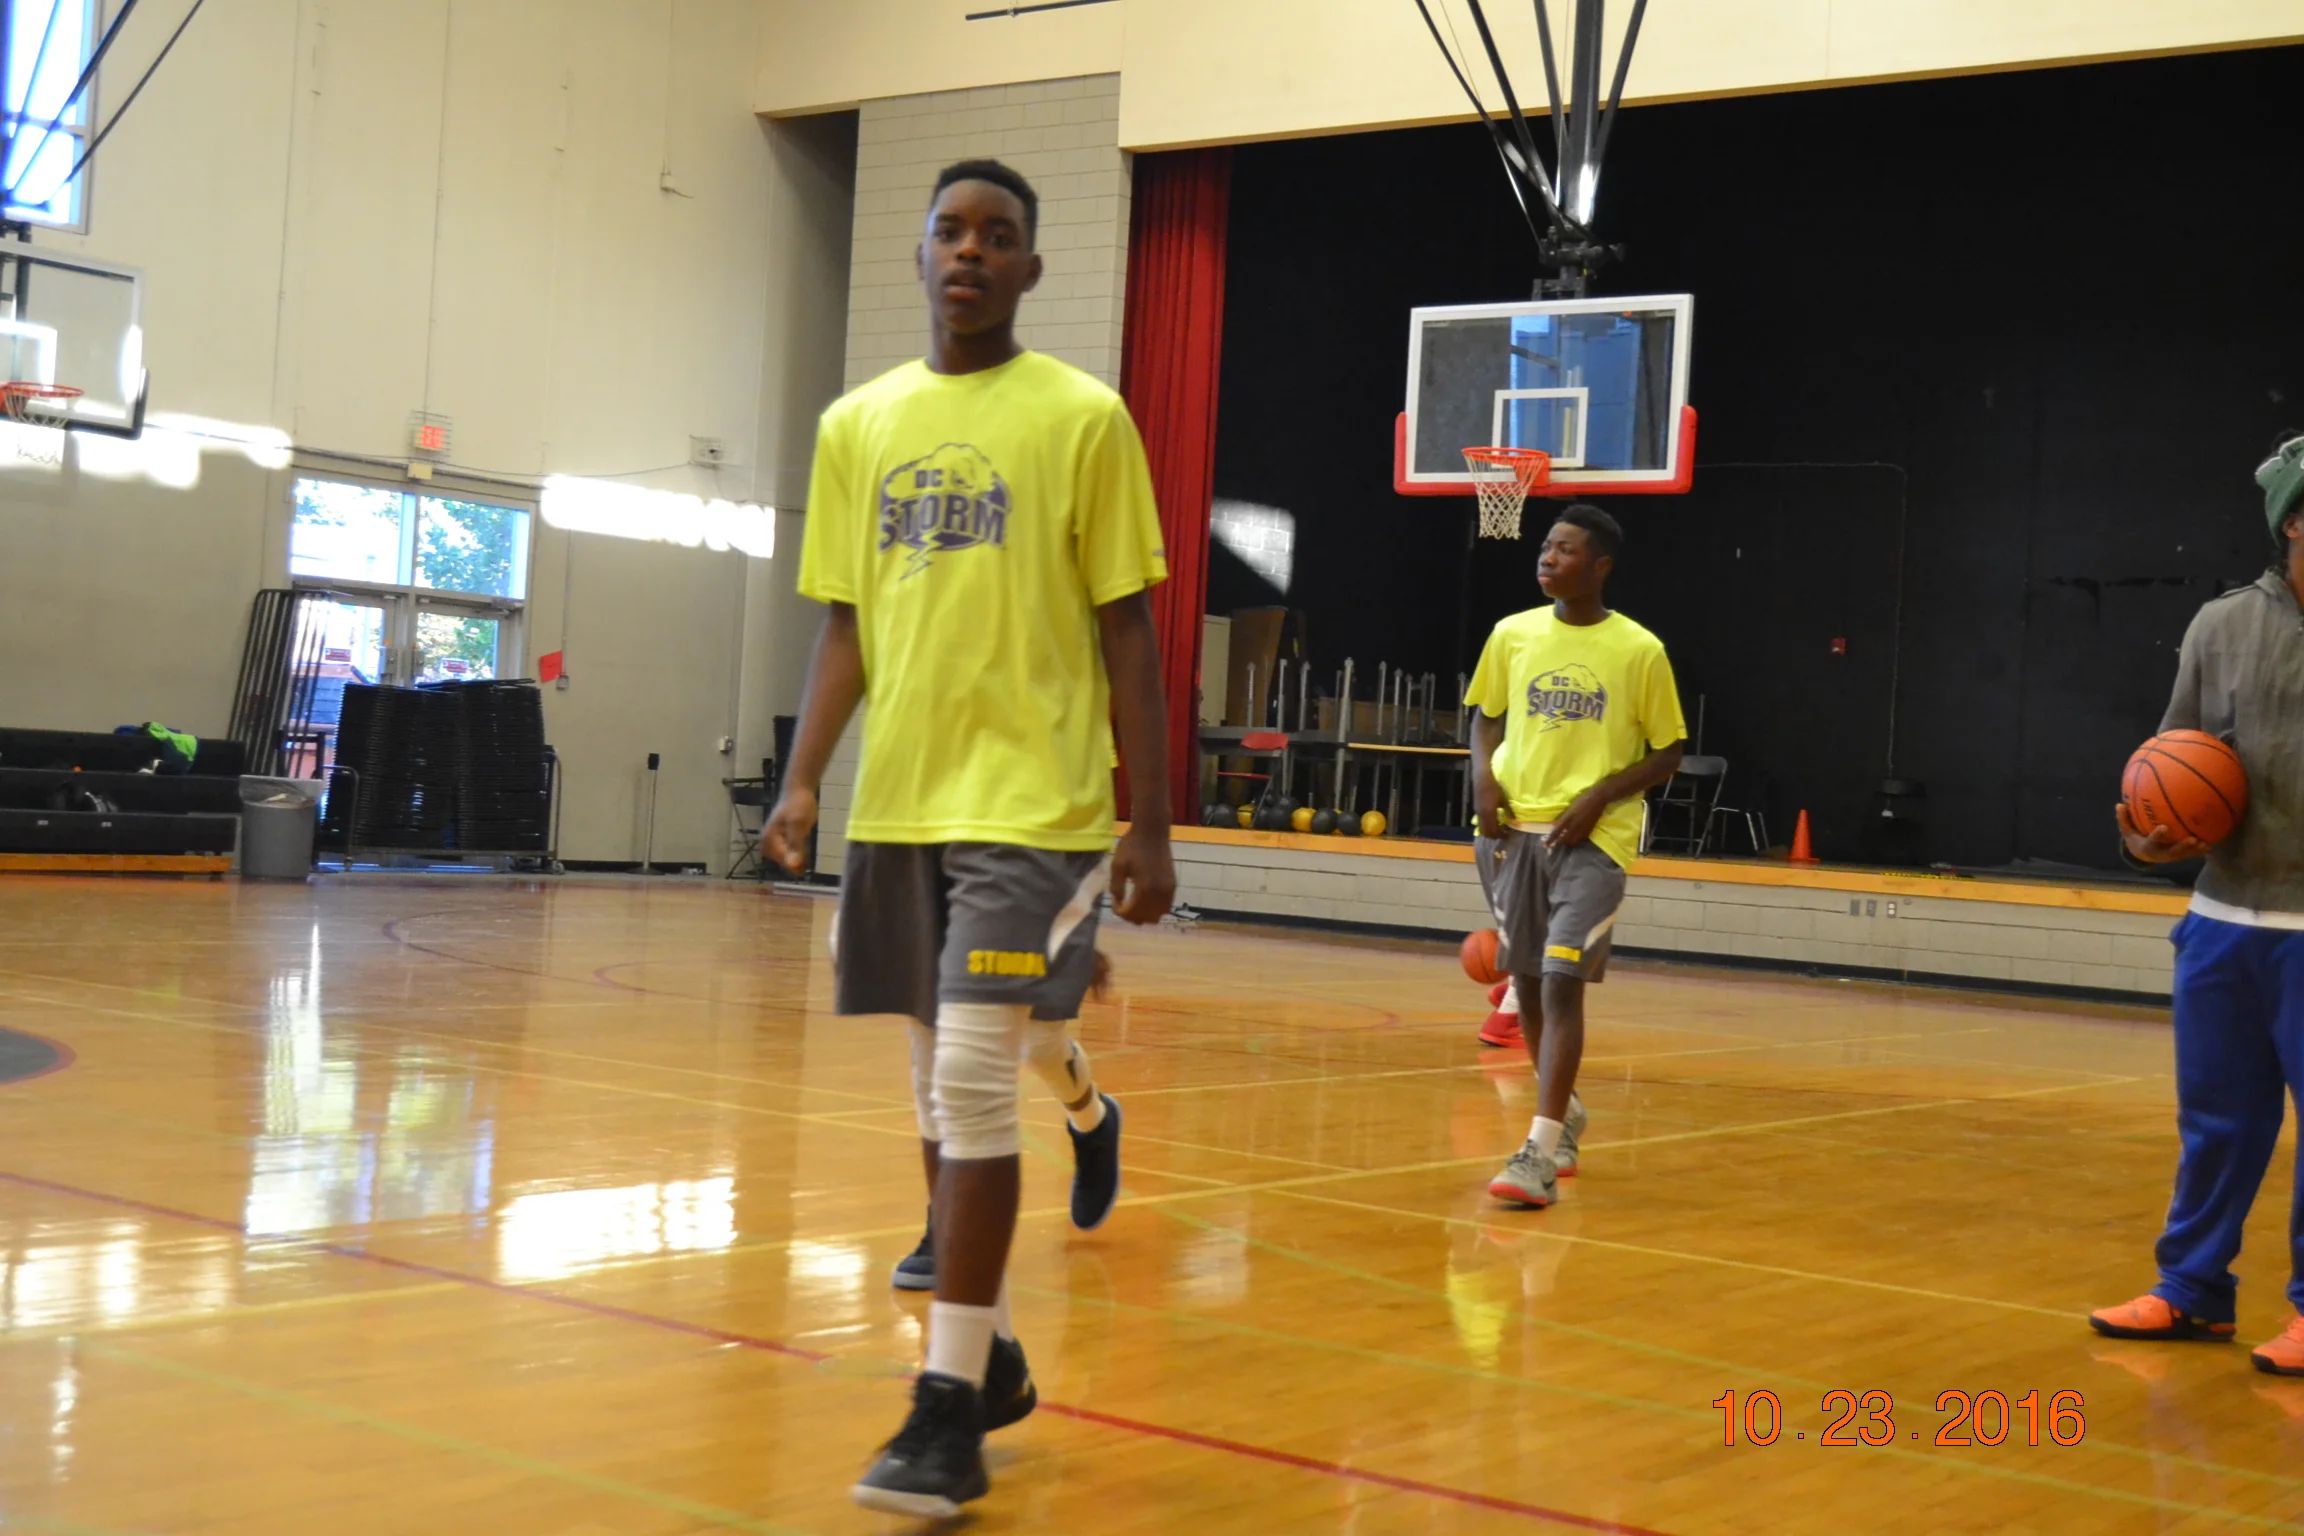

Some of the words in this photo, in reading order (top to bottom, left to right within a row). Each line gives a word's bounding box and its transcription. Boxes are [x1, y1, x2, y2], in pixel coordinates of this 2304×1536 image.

[914, 469, 944, 489] DC
[879, 493, 1007, 551] STORM
[1551, 675, 1571, 687] DC
[1527, 689, 1604, 723] STORM
